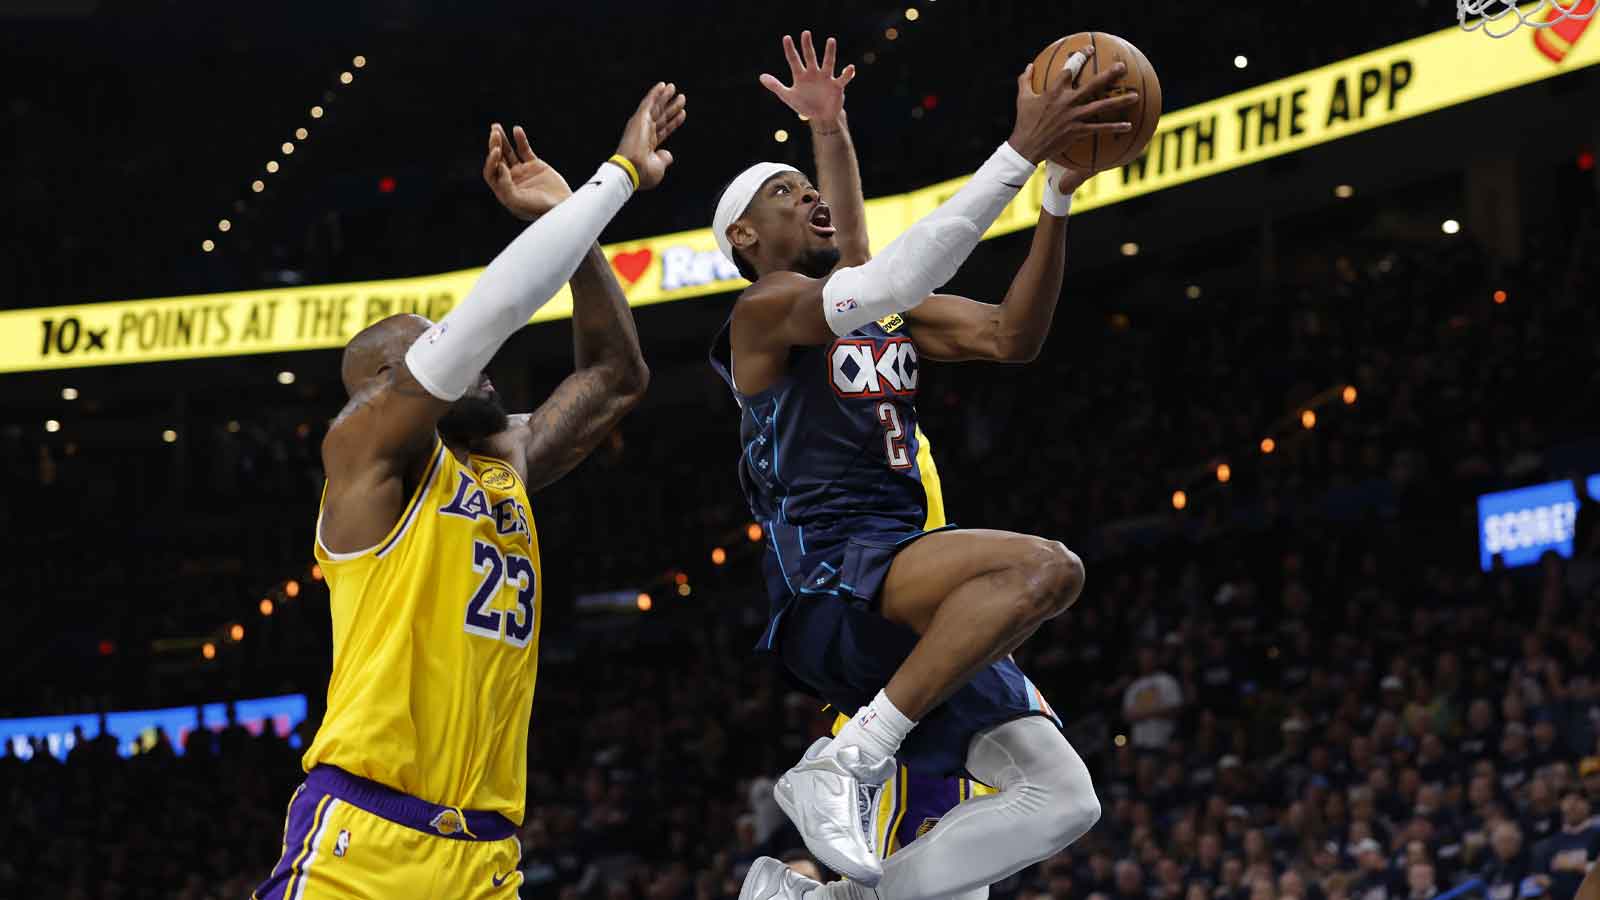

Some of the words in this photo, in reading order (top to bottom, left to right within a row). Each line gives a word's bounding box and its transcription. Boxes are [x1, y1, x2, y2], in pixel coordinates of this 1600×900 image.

[1236, 88, 1309, 153] THE
[1326, 59, 1414, 127] APP
[40, 316, 108, 356] 10x
[116, 302, 230, 352] POINTS
[240, 298, 279, 341] AT
[297, 294, 353, 339] THE
[827, 337, 920, 397] OKC
[877, 401, 912, 470] 2
[463, 538, 537, 649] 23
